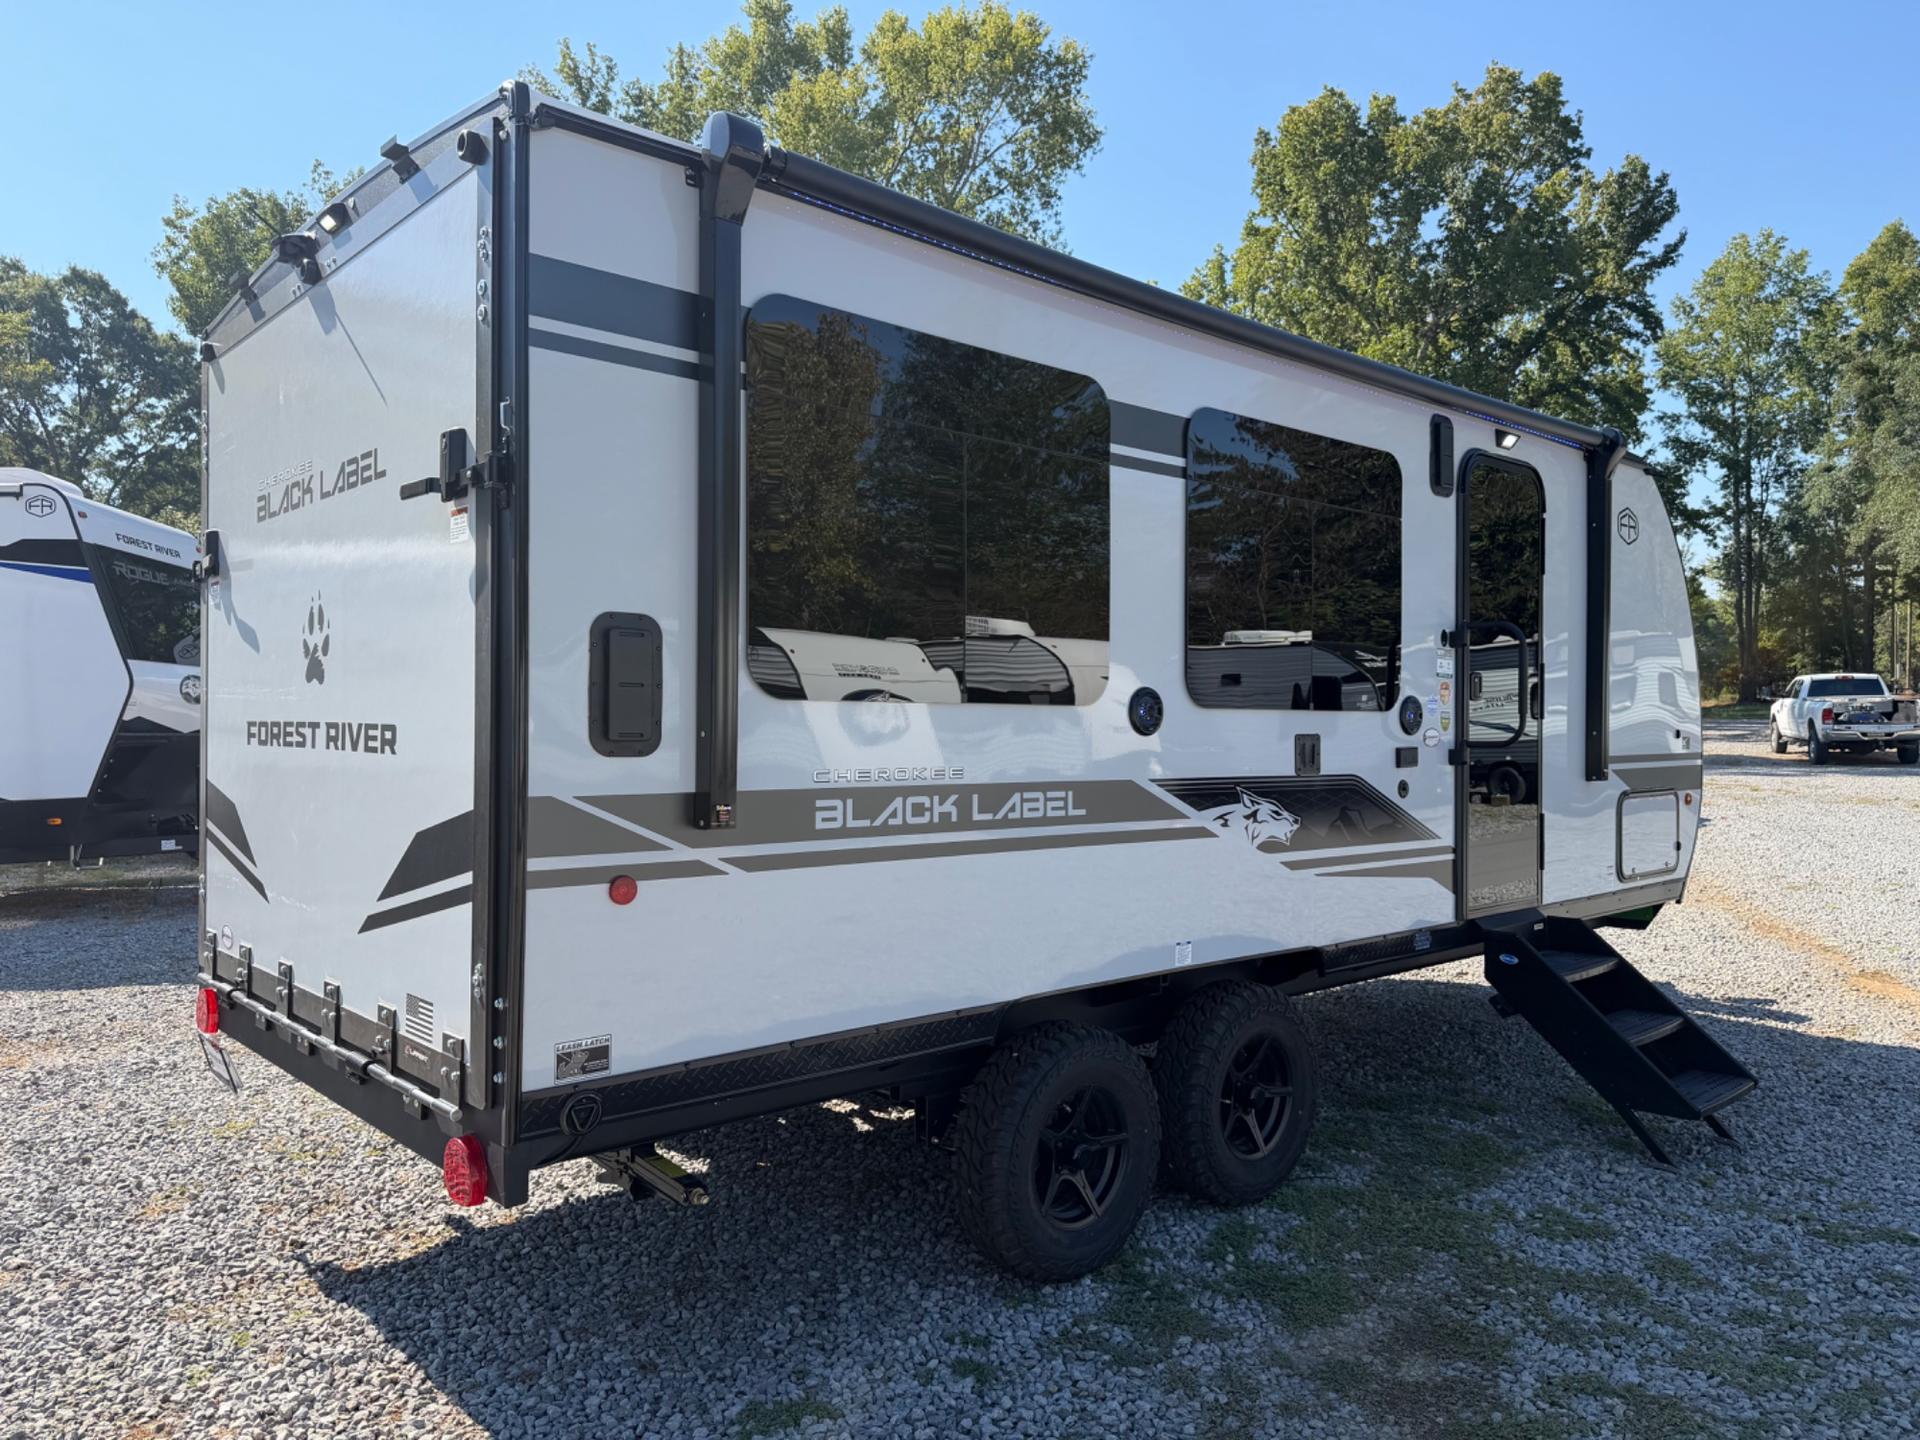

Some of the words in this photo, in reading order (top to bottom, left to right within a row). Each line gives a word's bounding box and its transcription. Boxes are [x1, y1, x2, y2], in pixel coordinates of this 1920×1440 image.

[256, 474, 314, 523] BLACK
[319, 447, 387, 500] LABEL
[115, 532, 154, 552] FOREST
[154, 544, 181, 559] RIVER
[112, 561, 170, 586] ROGUE
[246, 720, 321, 749] FOREST
[324, 721, 398, 755] RIVER
[812, 766, 966, 784] CHEROKEE
[815, 794, 960, 830] BLACK
[972, 790, 1087, 821] LABEL
[556, 1041, 583, 1052] LEASH
[584, 1036, 610, 1047] LATCH
